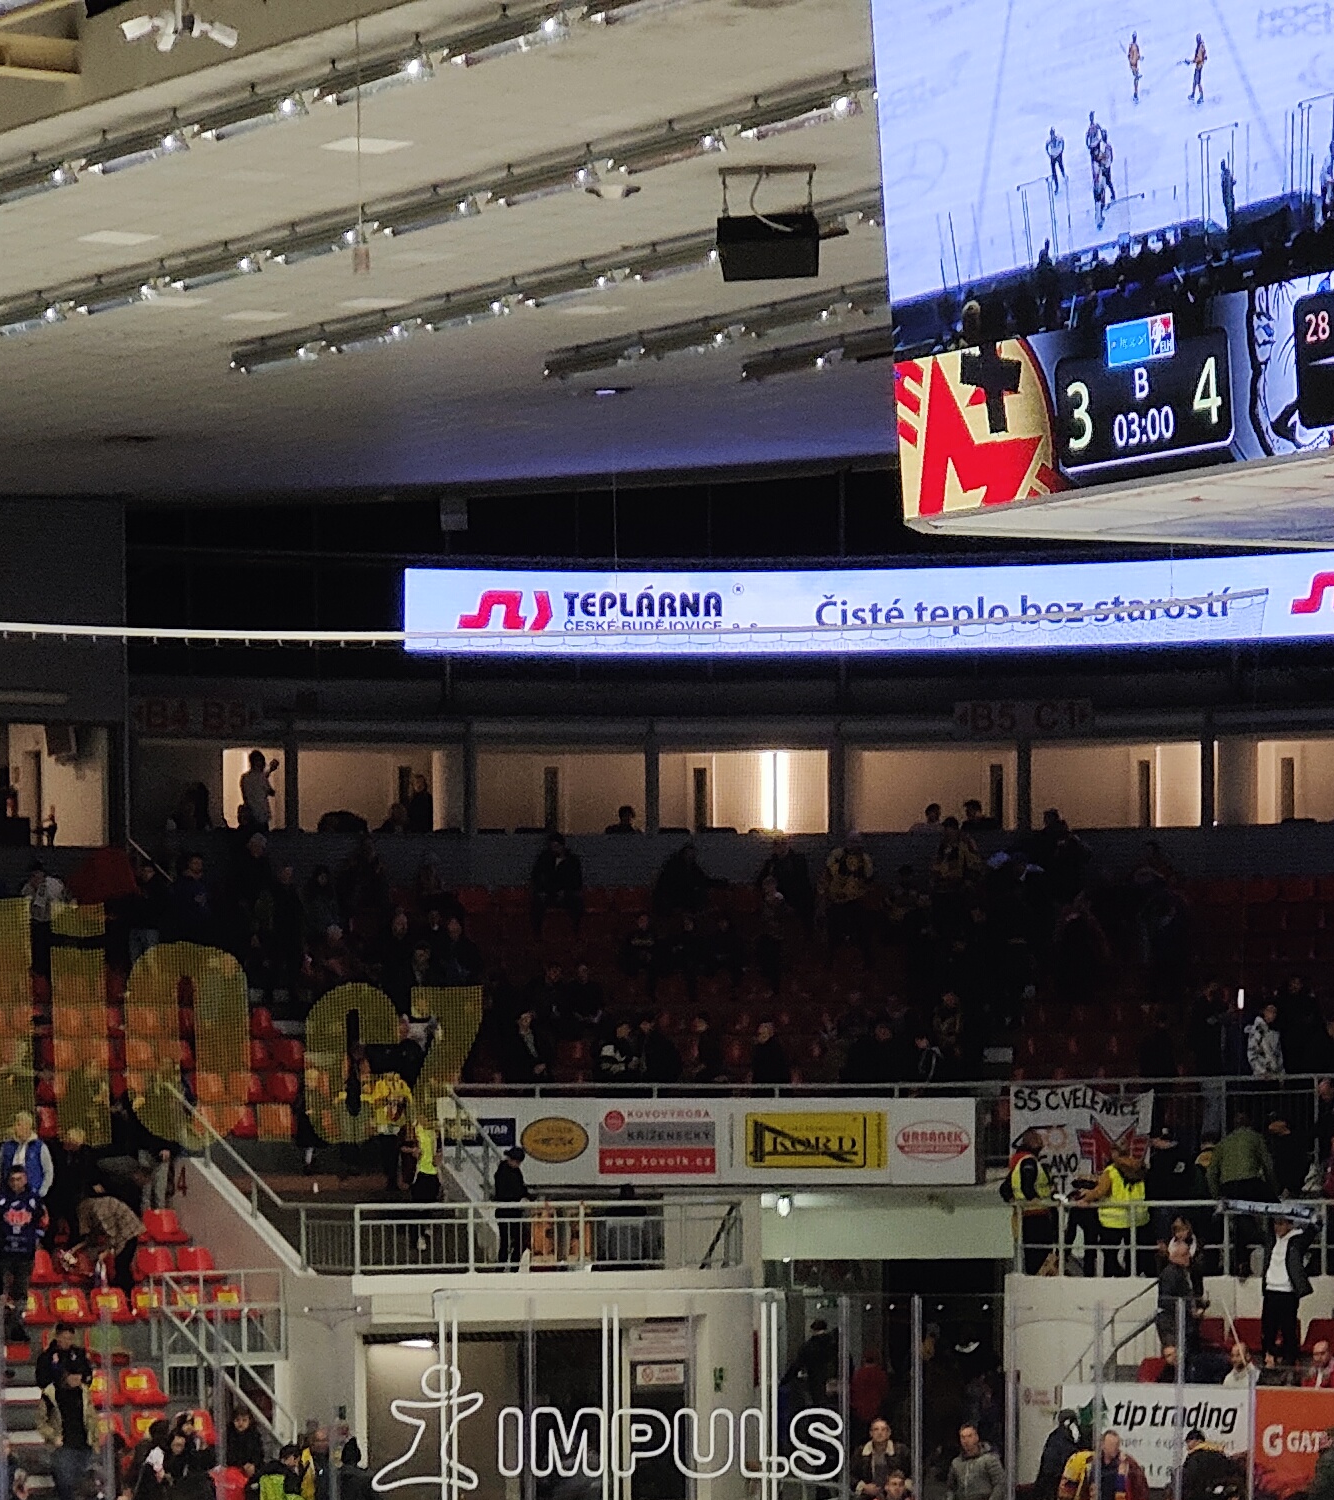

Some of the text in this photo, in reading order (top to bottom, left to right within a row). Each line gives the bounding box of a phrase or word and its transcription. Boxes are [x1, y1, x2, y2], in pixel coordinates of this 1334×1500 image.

[1305, 311, 1330, 342] 28
[1134, 367, 1150, 400] B
[1192, 356, 1222, 424] 4
[1066, 381, 1093, 450] 3
[1113, 405, 1175, 448] 03:00
[564, 585, 723, 617] TEPLÁRNA
[816, 586, 1233, 634] Čisté teplo bez starostí
[1112, 1400, 1239, 1433] tip trading
[497, 1405, 846, 1481] IMPULS
